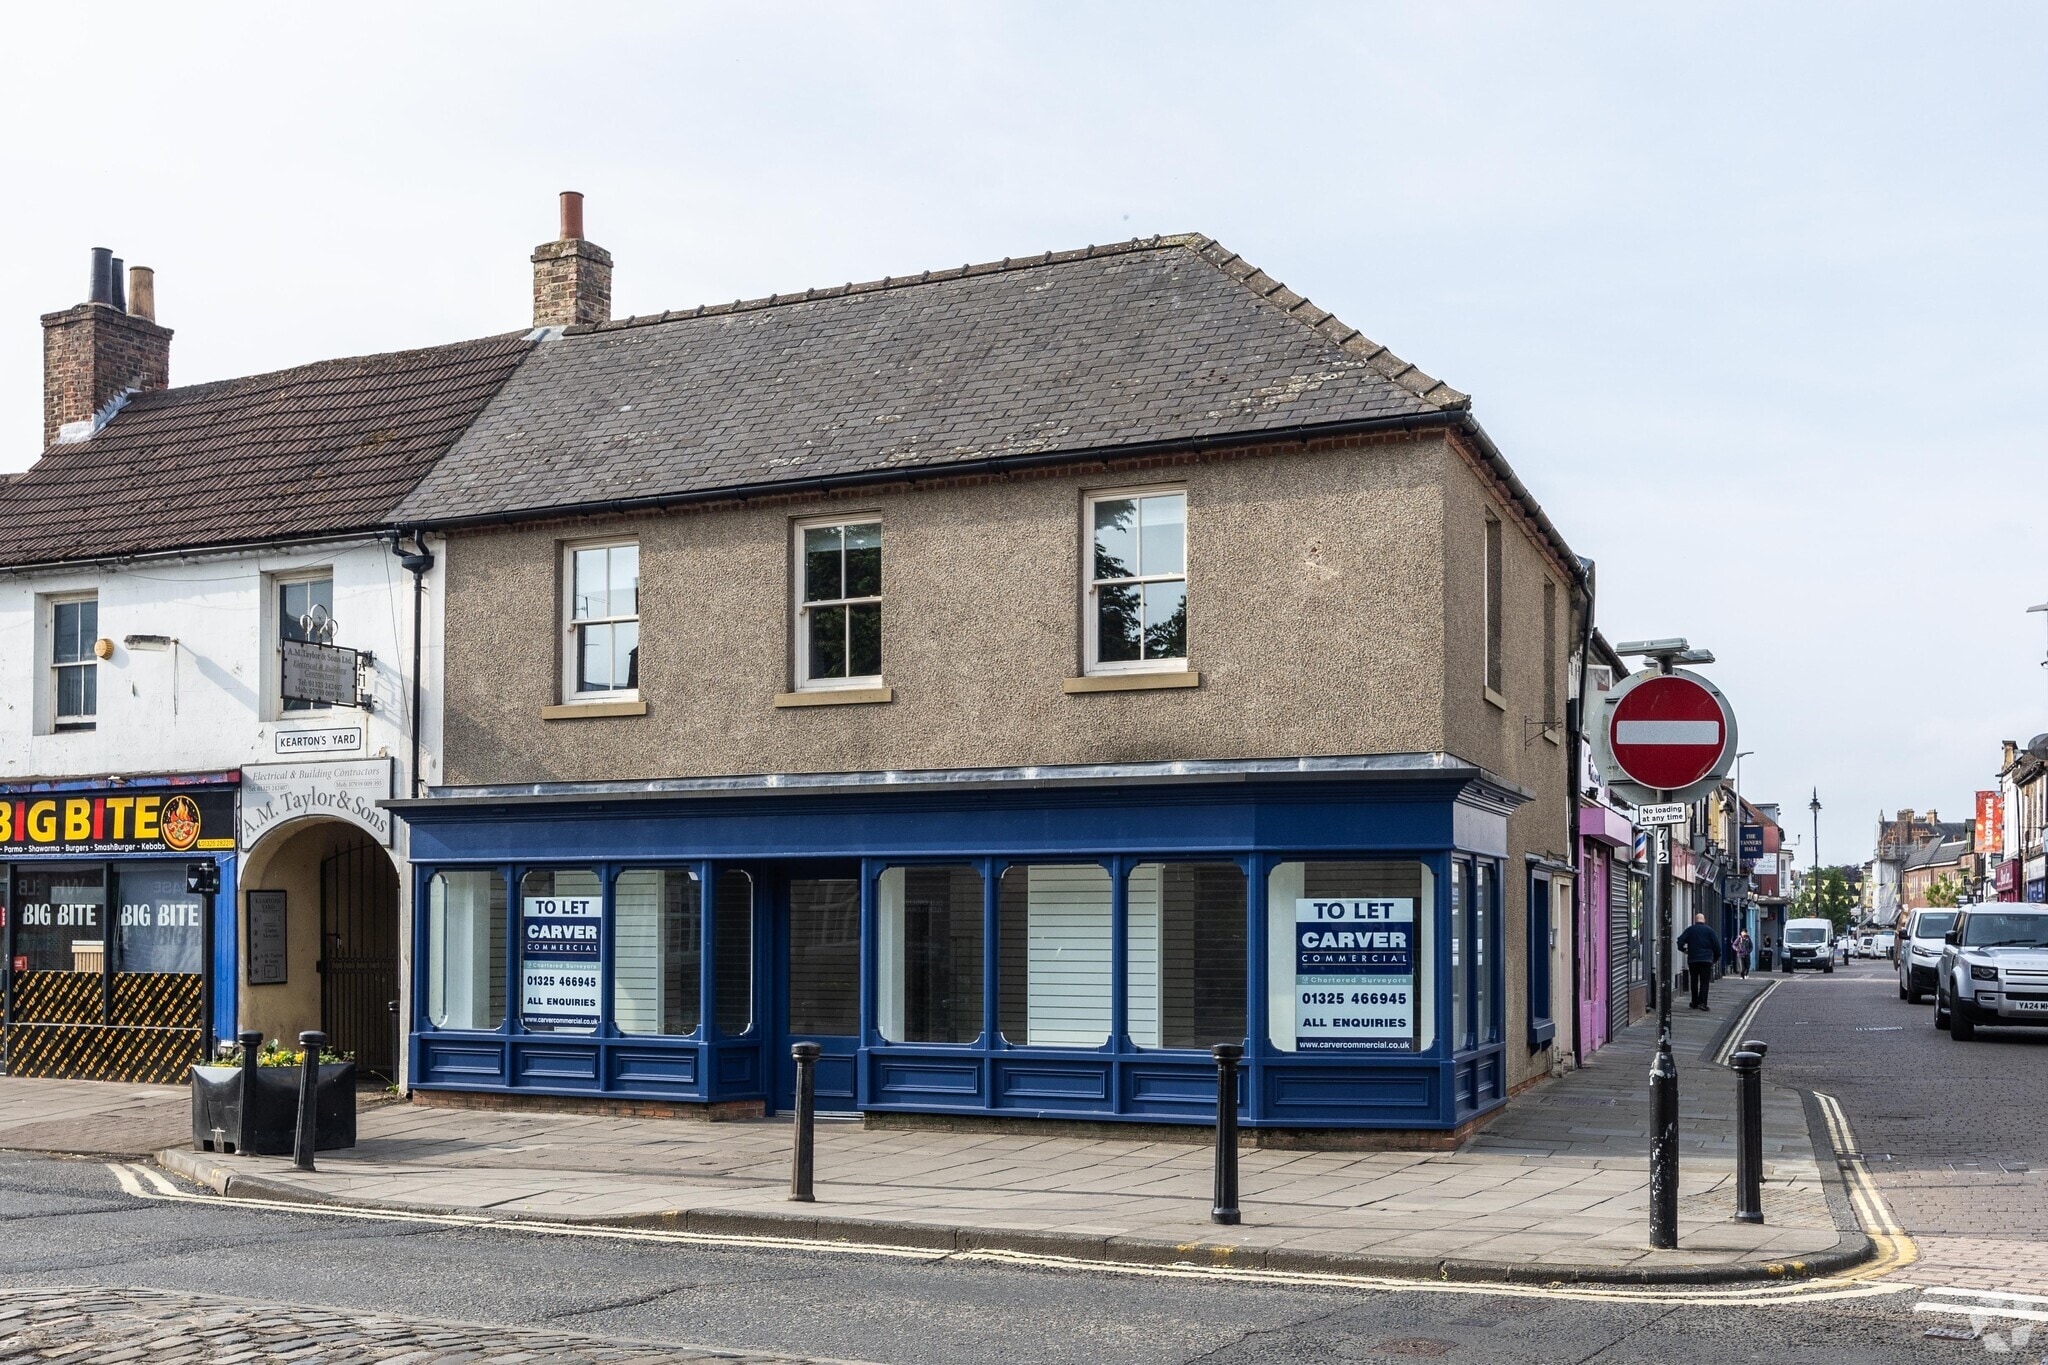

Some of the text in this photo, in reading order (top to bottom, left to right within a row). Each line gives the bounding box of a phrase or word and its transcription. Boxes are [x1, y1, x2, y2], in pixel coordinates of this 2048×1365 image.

[327, 653, 341, 662] Sons
[342, 656, 353, 664] Ltd.
[293, 660, 318, 669] Electrical
[325, 665, 347, 675] Building
[304, 670, 335, 679] Contractors
[280, 734, 356, 747] KEARTON'S YARD
[253, 766, 380, 781] Electrical & Building Contractors
[1655, 806, 1682, 814] loading
[64, 796, 161, 841] BITE
[243, 800, 280, 839] A.M.
[1984, 798, 1994, 846] PLAY SLOTS
[3, 842, 166, 853] Parmo Shawarma Burgers SmashBurger Kebabs
[536, 900, 589, 914] TO LET
[1313, 902, 1394, 919] TO LET
[23, 903, 51, 926] BIG
[57, 903, 97, 926] BITE
[120, 903, 199, 927] BIG BITE
[527, 924, 598, 939] CARVER
[1301, 932, 1406, 948] CARVER
[527, 943, 597, 952] COMMERCIAL
[1301, 954, 1407, 962] COMMERCIAL
[527, 976, 596, 987] 01325 466945
[1311, 976, 1407, 985] Chartered Surveyors
[527, 997, 596, 1007] ALL ENQUIRIES
[1302, 992, 1406, 1005] 01325 466945
[2019, 1002, 2039, 1010] YA24
[525, 1016, 598, 1026] www.carvercommercial.co.uk
[1303, 1018, 1406, 1028] ALL ENQUIRIES
[1300, 1040, 1410, 1049] www.carvercommercial.co.uk
